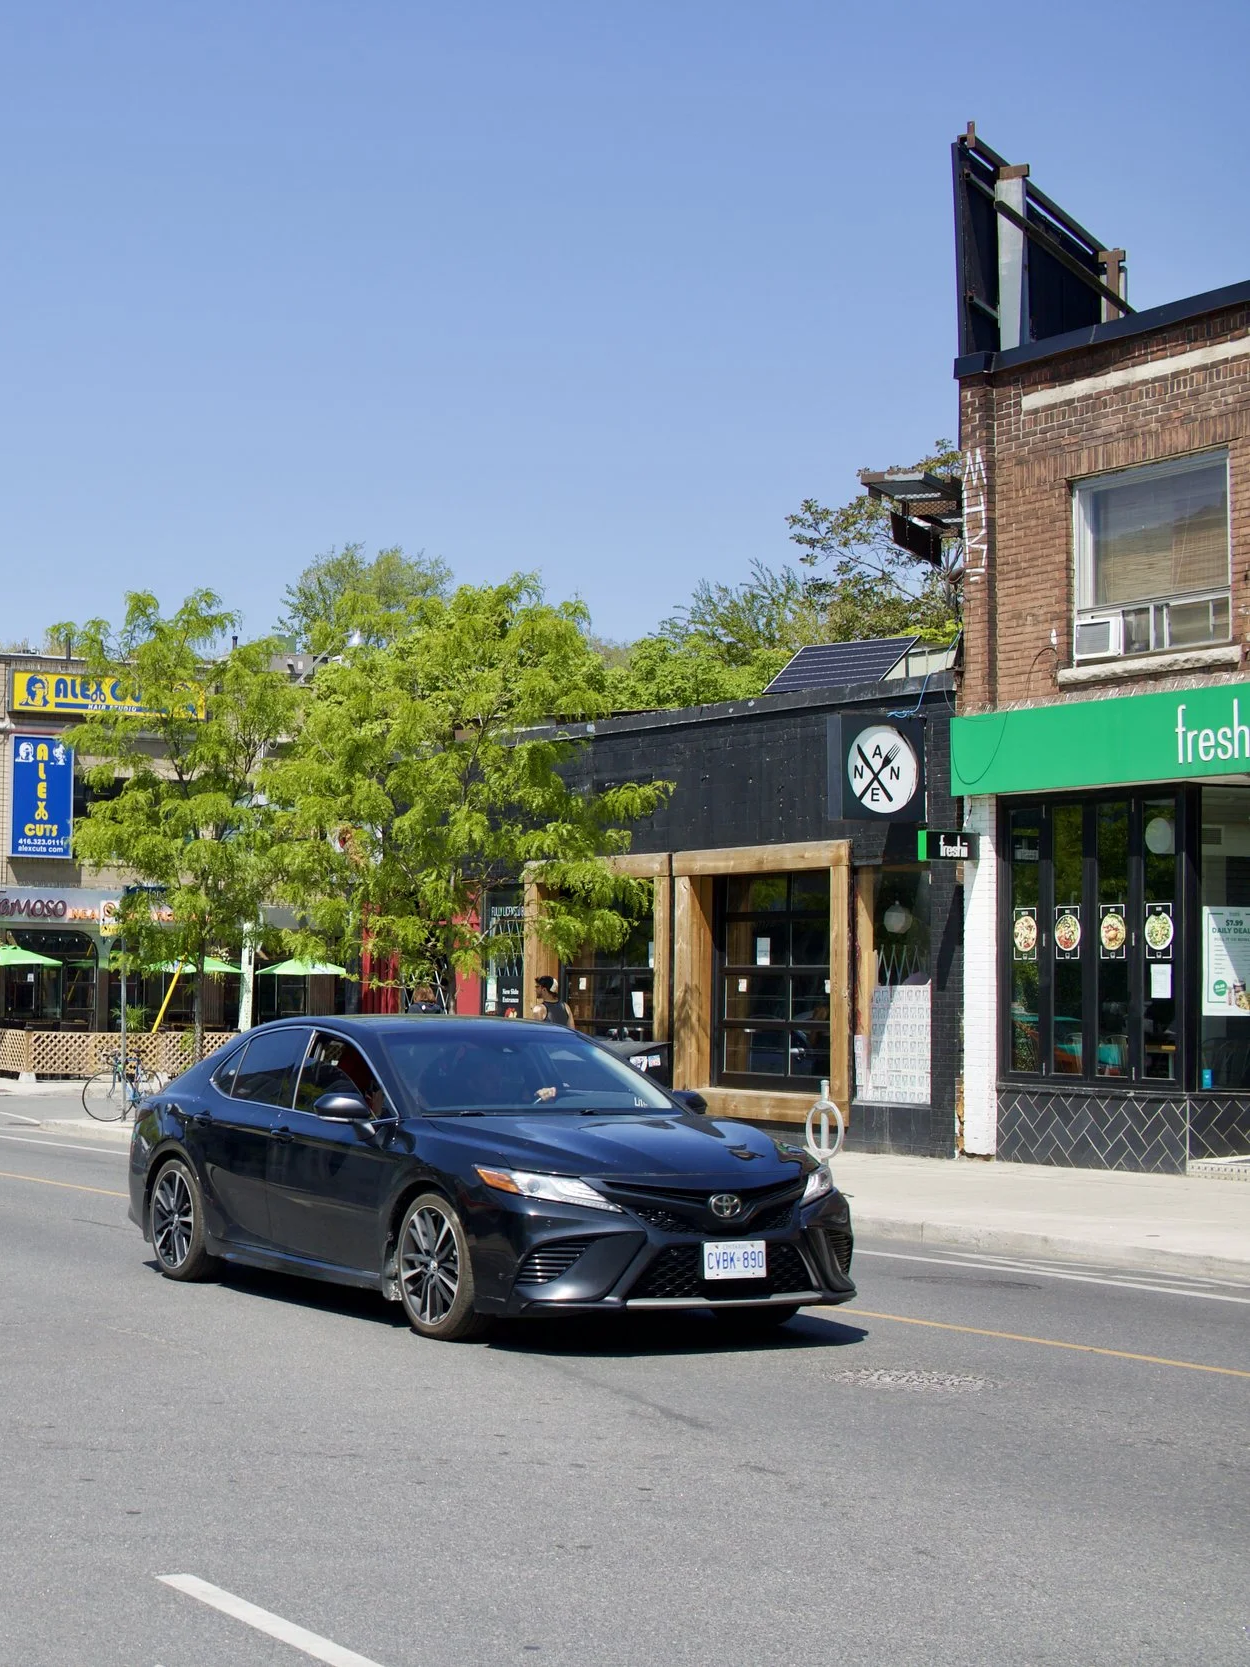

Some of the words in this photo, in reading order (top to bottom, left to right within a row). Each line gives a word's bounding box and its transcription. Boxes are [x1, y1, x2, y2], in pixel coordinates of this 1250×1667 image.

[55, 678, 106, 703] ALEX
[34, 743, 49, 821] ALEX
[24, 823, 58, 837] CUTS
[939, 834, 969, 858] freshii
[1225, 919, 1244, 927] $7.99
